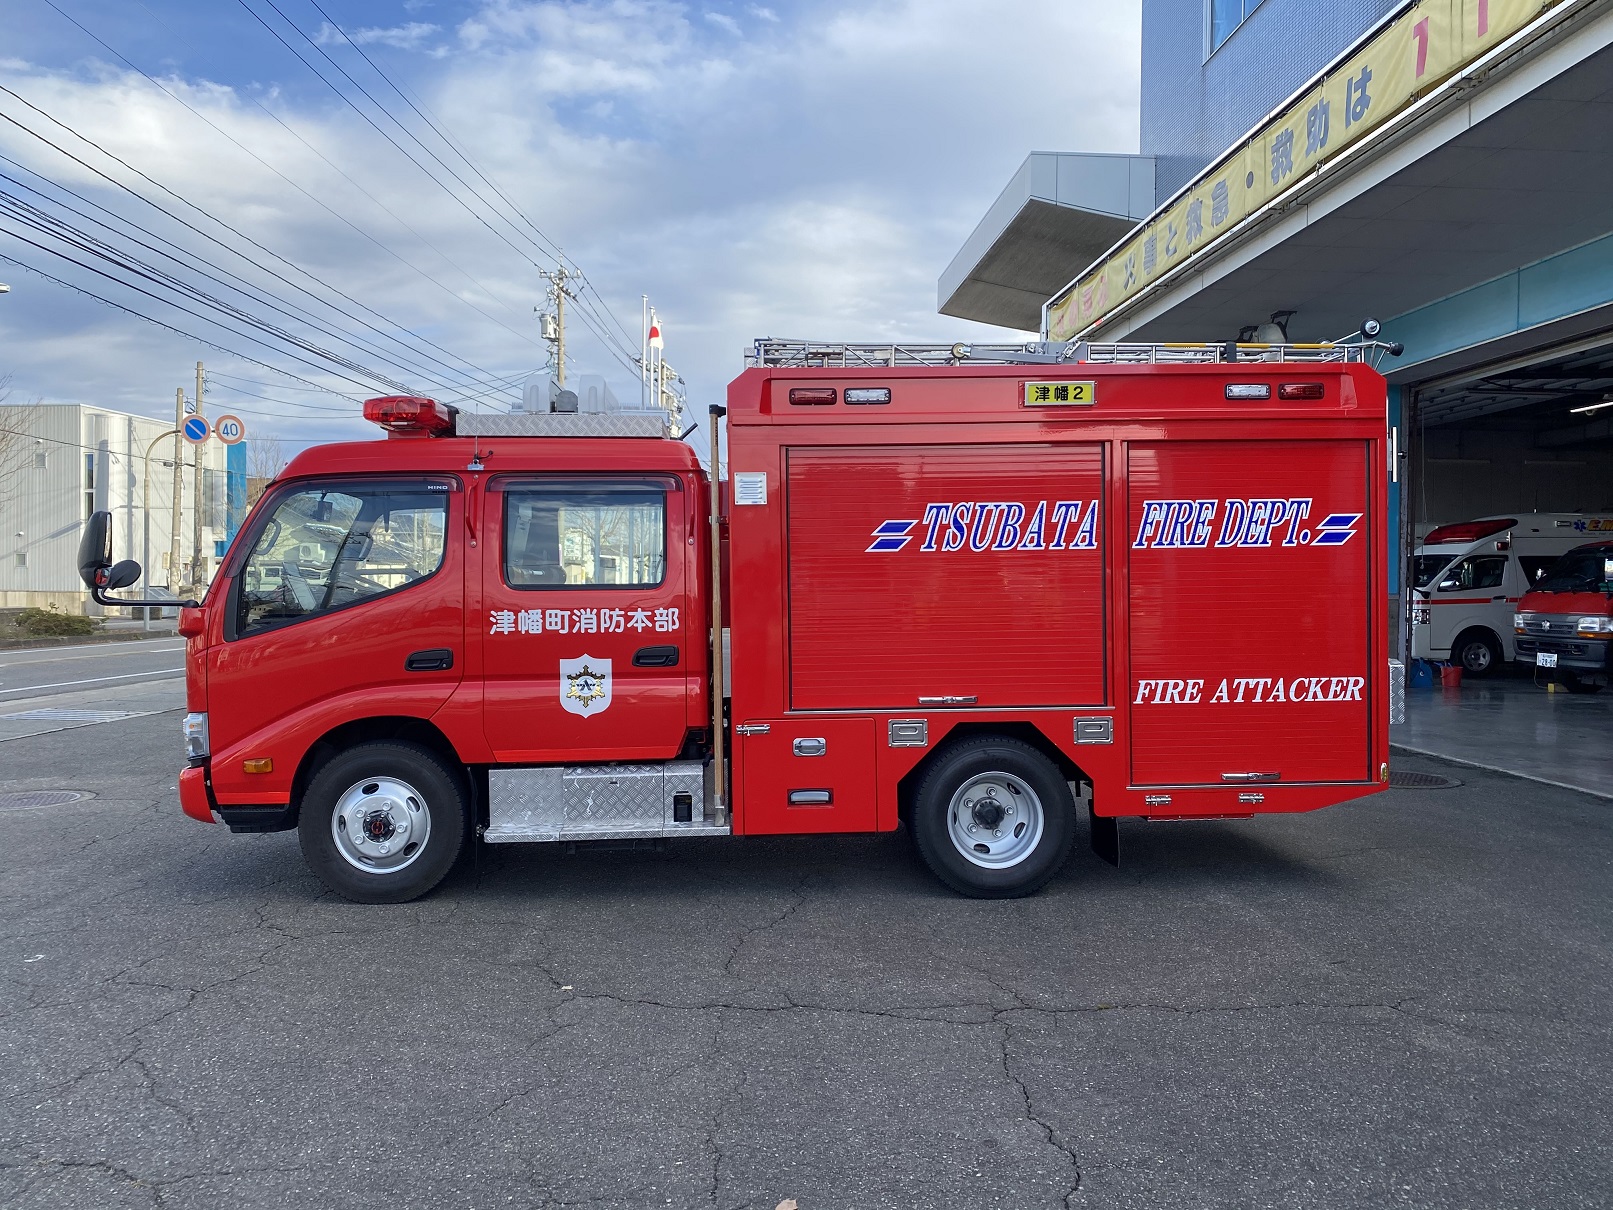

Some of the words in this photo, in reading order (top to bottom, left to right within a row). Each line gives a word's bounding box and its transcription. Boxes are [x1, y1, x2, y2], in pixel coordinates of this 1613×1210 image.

[1034, 385, 1084, 402] 津幡2
[222, 423, 238, 436] 40
[920, 500, 1100, 552] TSUBATA
[1132, 499, 1218, 549] FIRE
[1215, 498, 1313, 547] DEPT.
[489, 608, 680, 635] 津幡町消防本部
[1133, 678, 1205, 704] FIRE
[1209, 676, 1365, 703] ATTACKER
